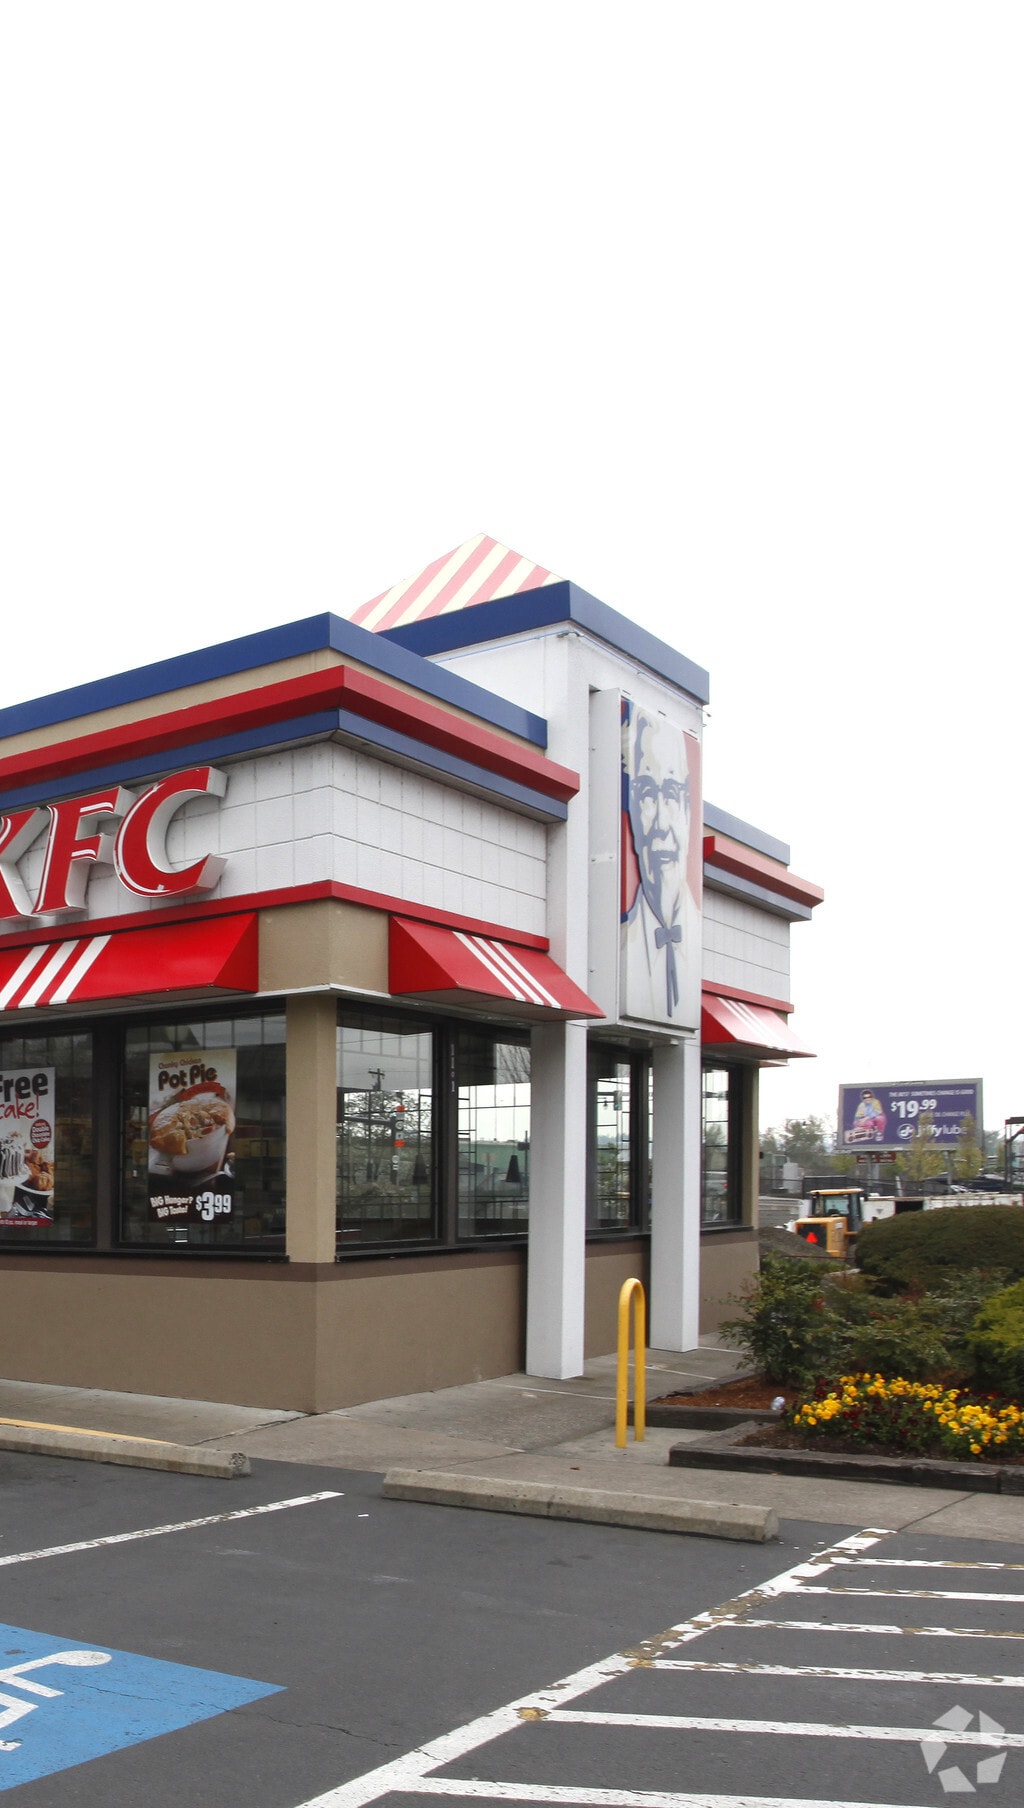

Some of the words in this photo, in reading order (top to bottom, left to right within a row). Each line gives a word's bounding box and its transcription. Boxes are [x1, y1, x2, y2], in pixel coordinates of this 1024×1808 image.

[158, 1070, 187, 1091] Pot
[190, 1063, 217, 1085] Pie
[890, 1099, 937, 1118] $19.99
